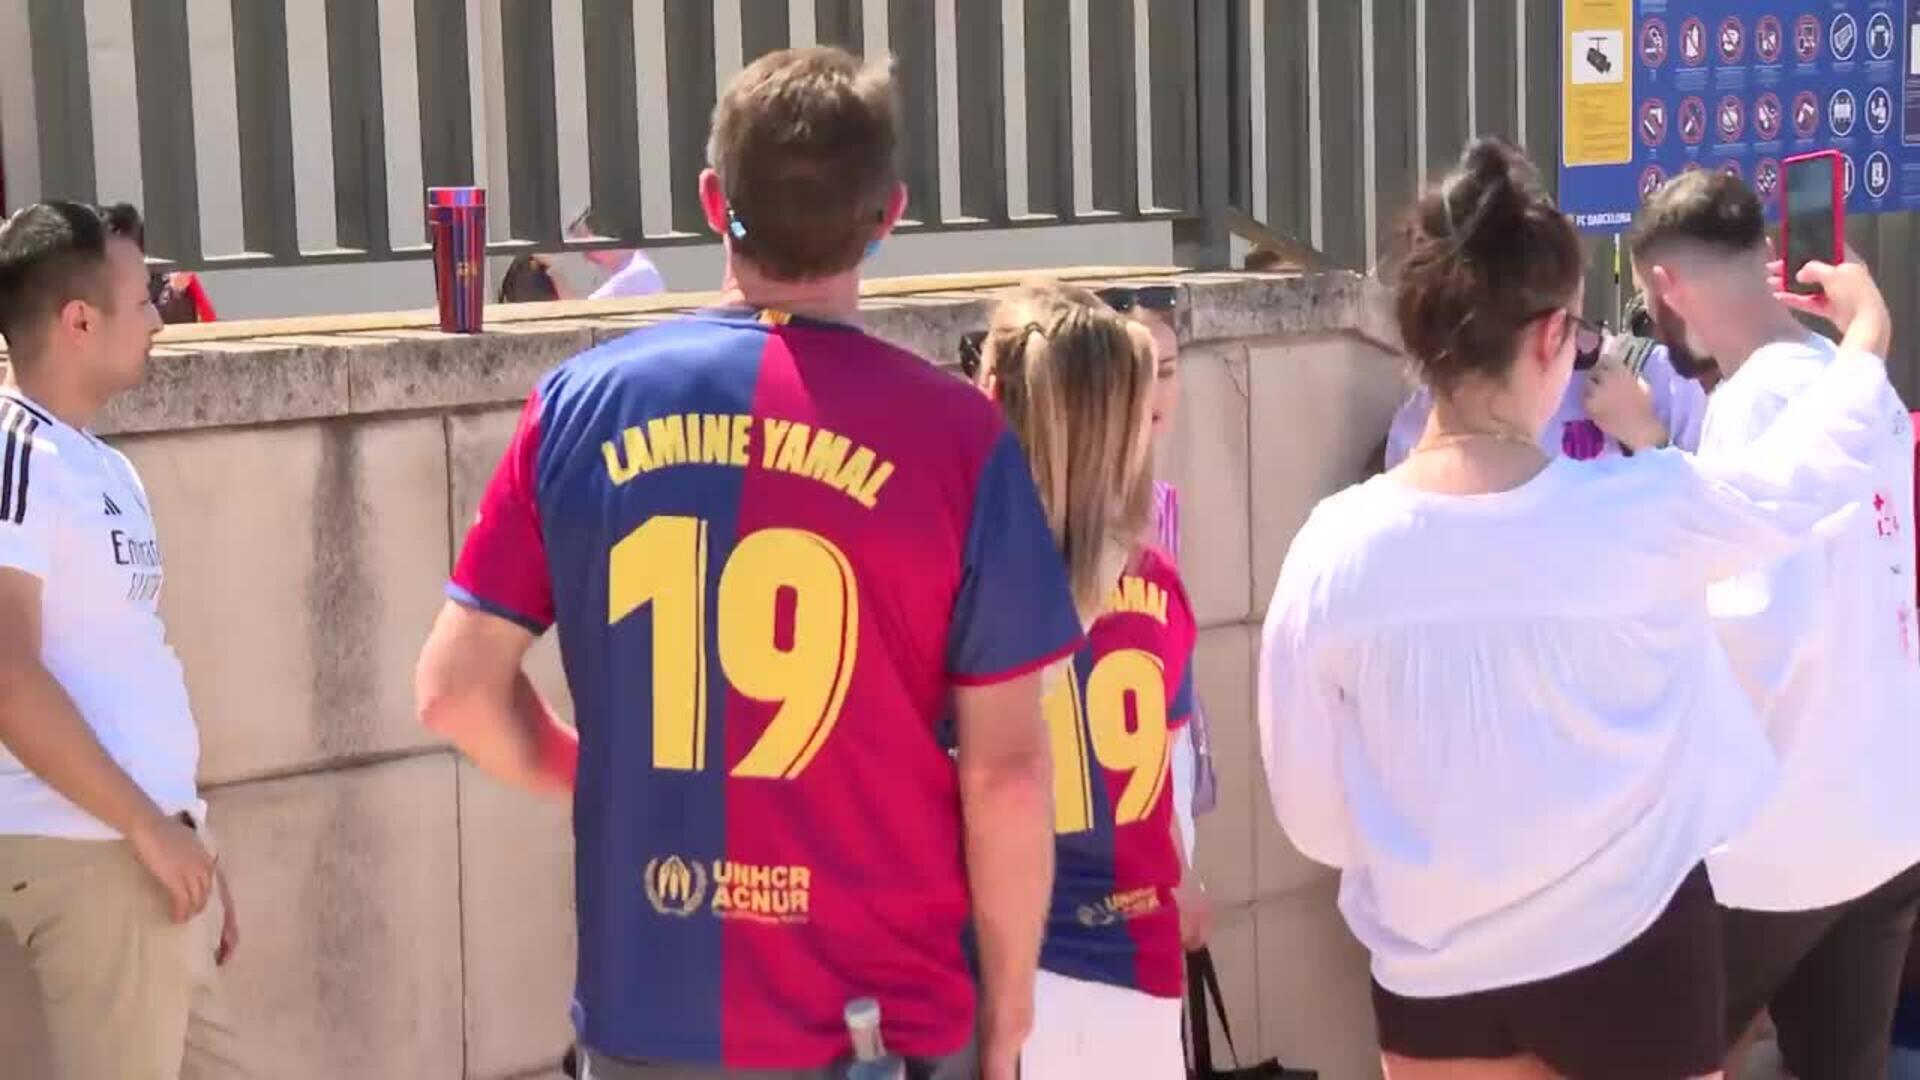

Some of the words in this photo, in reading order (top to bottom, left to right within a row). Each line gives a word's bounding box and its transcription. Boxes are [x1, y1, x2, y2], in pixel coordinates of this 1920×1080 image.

[1576, 214, 1586, 227] FC
[1587, 212, 1632, 226] BARCELONA
[602, 413, 753, 486] LAMINE
[761, 417, 895, 510] YAMAL
[1104, 575, 1168, 625] AMAL
[608, 515, 859, 780] 19
[1042, 648, 1172, 836] 19
[713, 859, 811, 889] UNHCR
[711, 887, 809, 913] ACNUR
